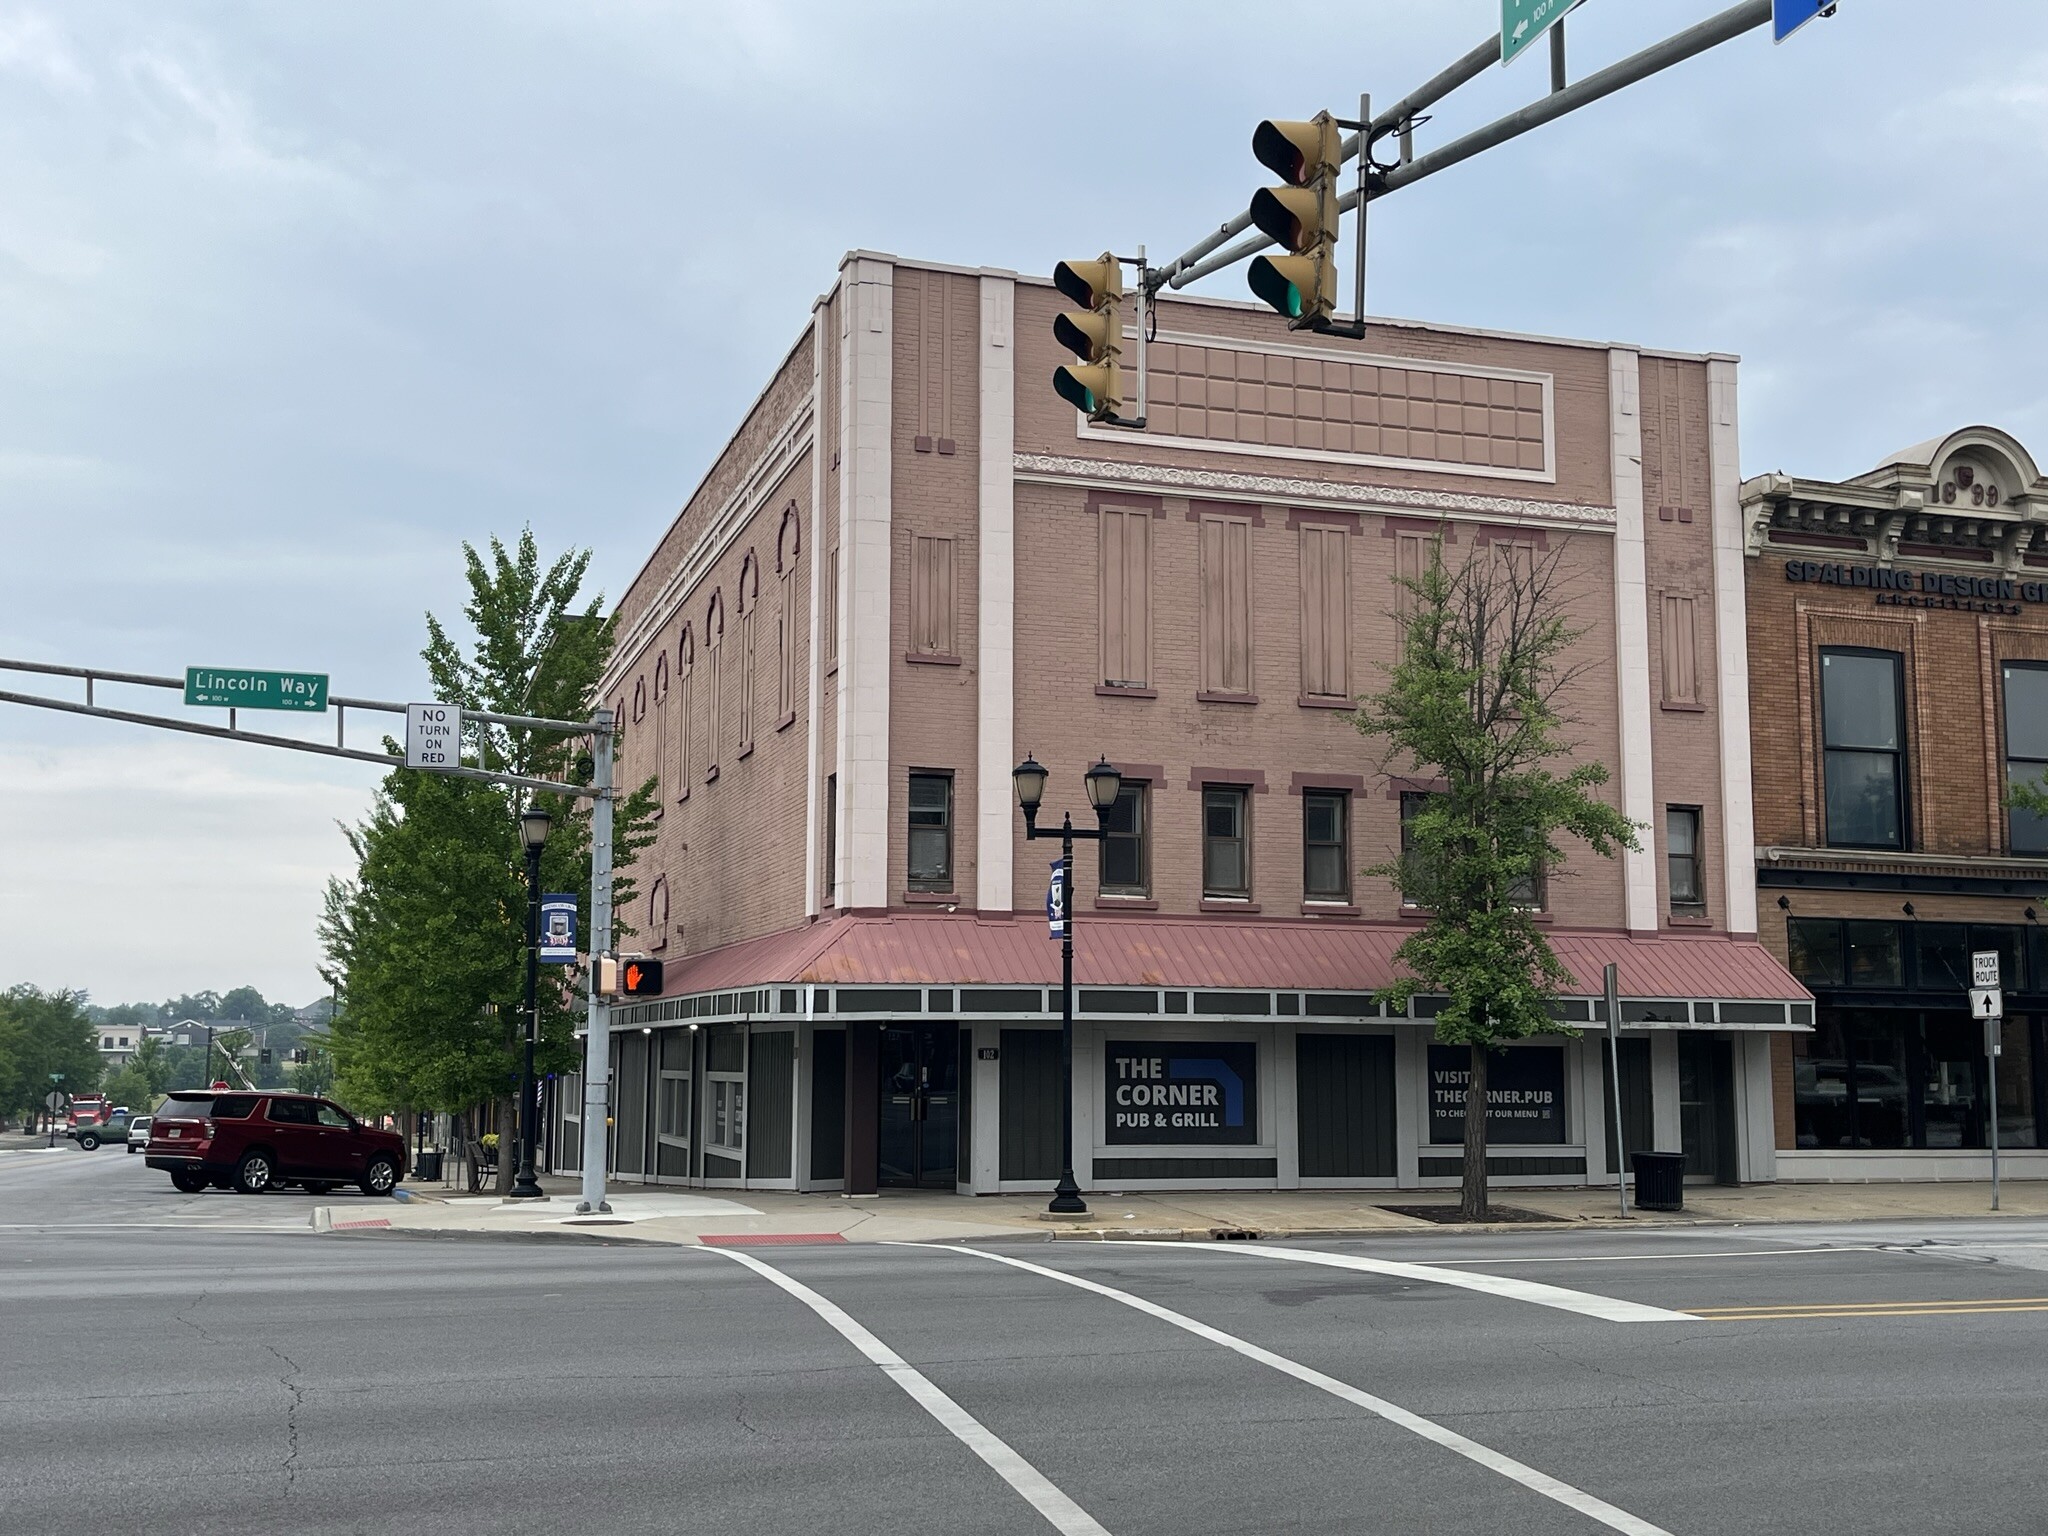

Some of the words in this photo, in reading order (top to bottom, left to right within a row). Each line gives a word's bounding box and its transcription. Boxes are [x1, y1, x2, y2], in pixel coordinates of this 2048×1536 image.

[1533, 2, 1546, 23] 100
[1932, 480, 1998, 507] 1899
[1786, 560, 1915, 591] SPALDING
[1921, 572, 2016, 600] DESIGN
[1876, 593, 2022, 616] ARCHITECTS
[195, 673, 267, 692] Lincoln
[281, 678, 319, 698] Way
[423, 709, 446, 722] NO
[419, 725, 450, 735] TURN
[426, 739, 442, 749] ON
[422, 753, 445, 763] RED
[1974, 957, 1997, 968] TRUCK
[1975, 970, 1998, 982] ROUTE
[1115, 1057, 1163, 1079] THE
[1434, 1070, 1471, 1084] VISIT
[1116, 1084, 1219, 1106] CORNER
[1434, 1090, 1553, 1104] THECRNER.PUB
[1116, 1113, 1150, 1127] PUB
[1154, 1113, 1167, 1127] &
[1171, 1113, 1219, 1127] GRILL
[1435, 1109, 1447, 1118] TO
[1495, 1110, 1513, 1118] OUR
[1514, 1110, 1539, 1118] MENU
